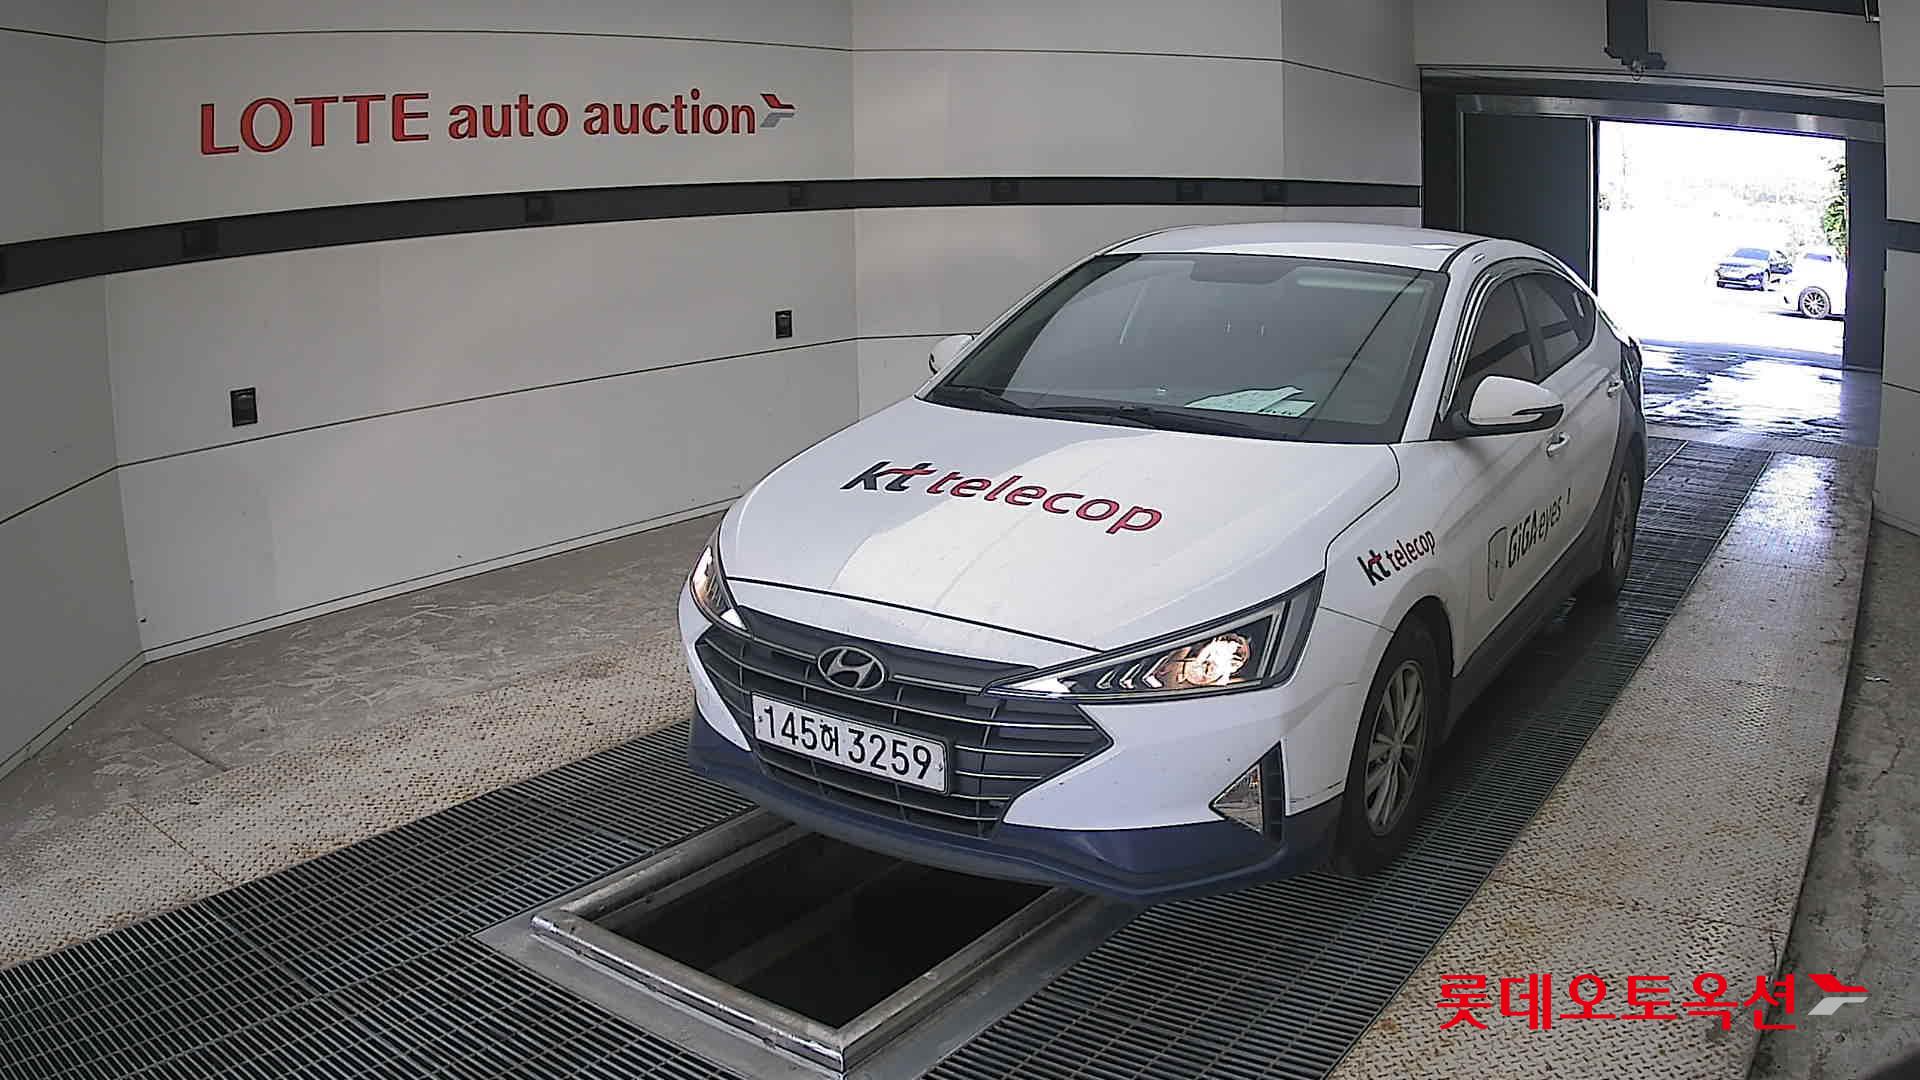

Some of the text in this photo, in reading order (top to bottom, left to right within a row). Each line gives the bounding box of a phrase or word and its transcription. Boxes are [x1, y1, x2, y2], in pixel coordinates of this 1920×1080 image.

[200, 89, 755, 156] LOTTE auto auction
[840, 461, 1163, 535] kt telecop
[1357, 530, 1436, 587] kt telecop
